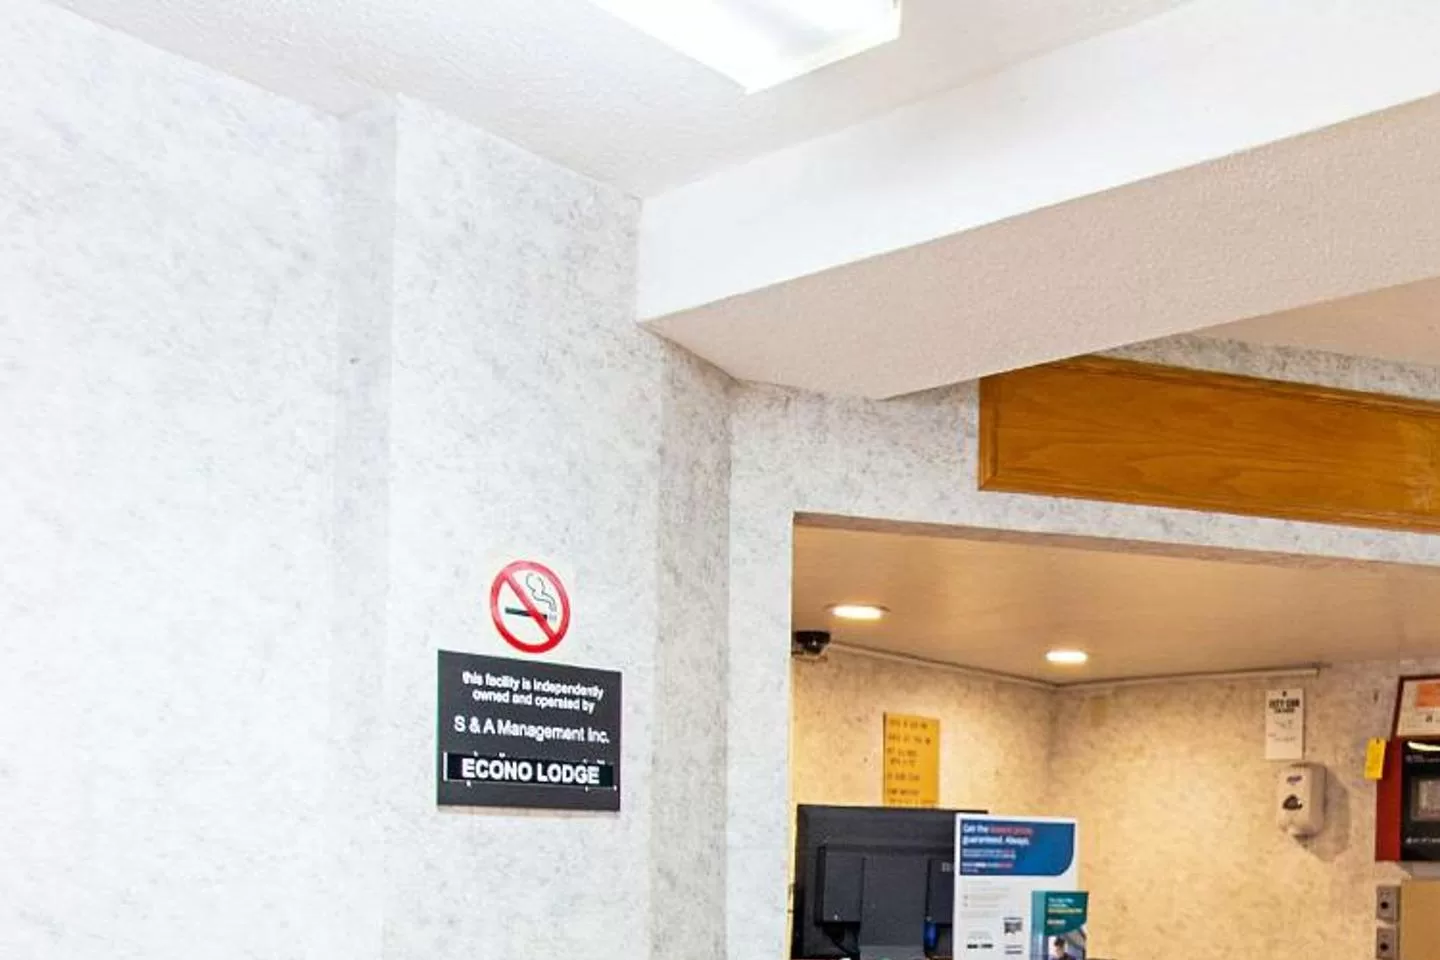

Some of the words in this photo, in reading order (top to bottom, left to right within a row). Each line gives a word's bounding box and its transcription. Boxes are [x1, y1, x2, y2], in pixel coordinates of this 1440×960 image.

[472, 689, 509, 704] owned
[454, 715, 467, 733] S
[469, 716, 482, 734] &
[483, 717, 496, 735] A
[497, 719, 586, 742] Management
[586, 727, 611, 744] Inc.
[461, 757, 533, 781] ECONO
[536, 762, 601, 785] LODGE
